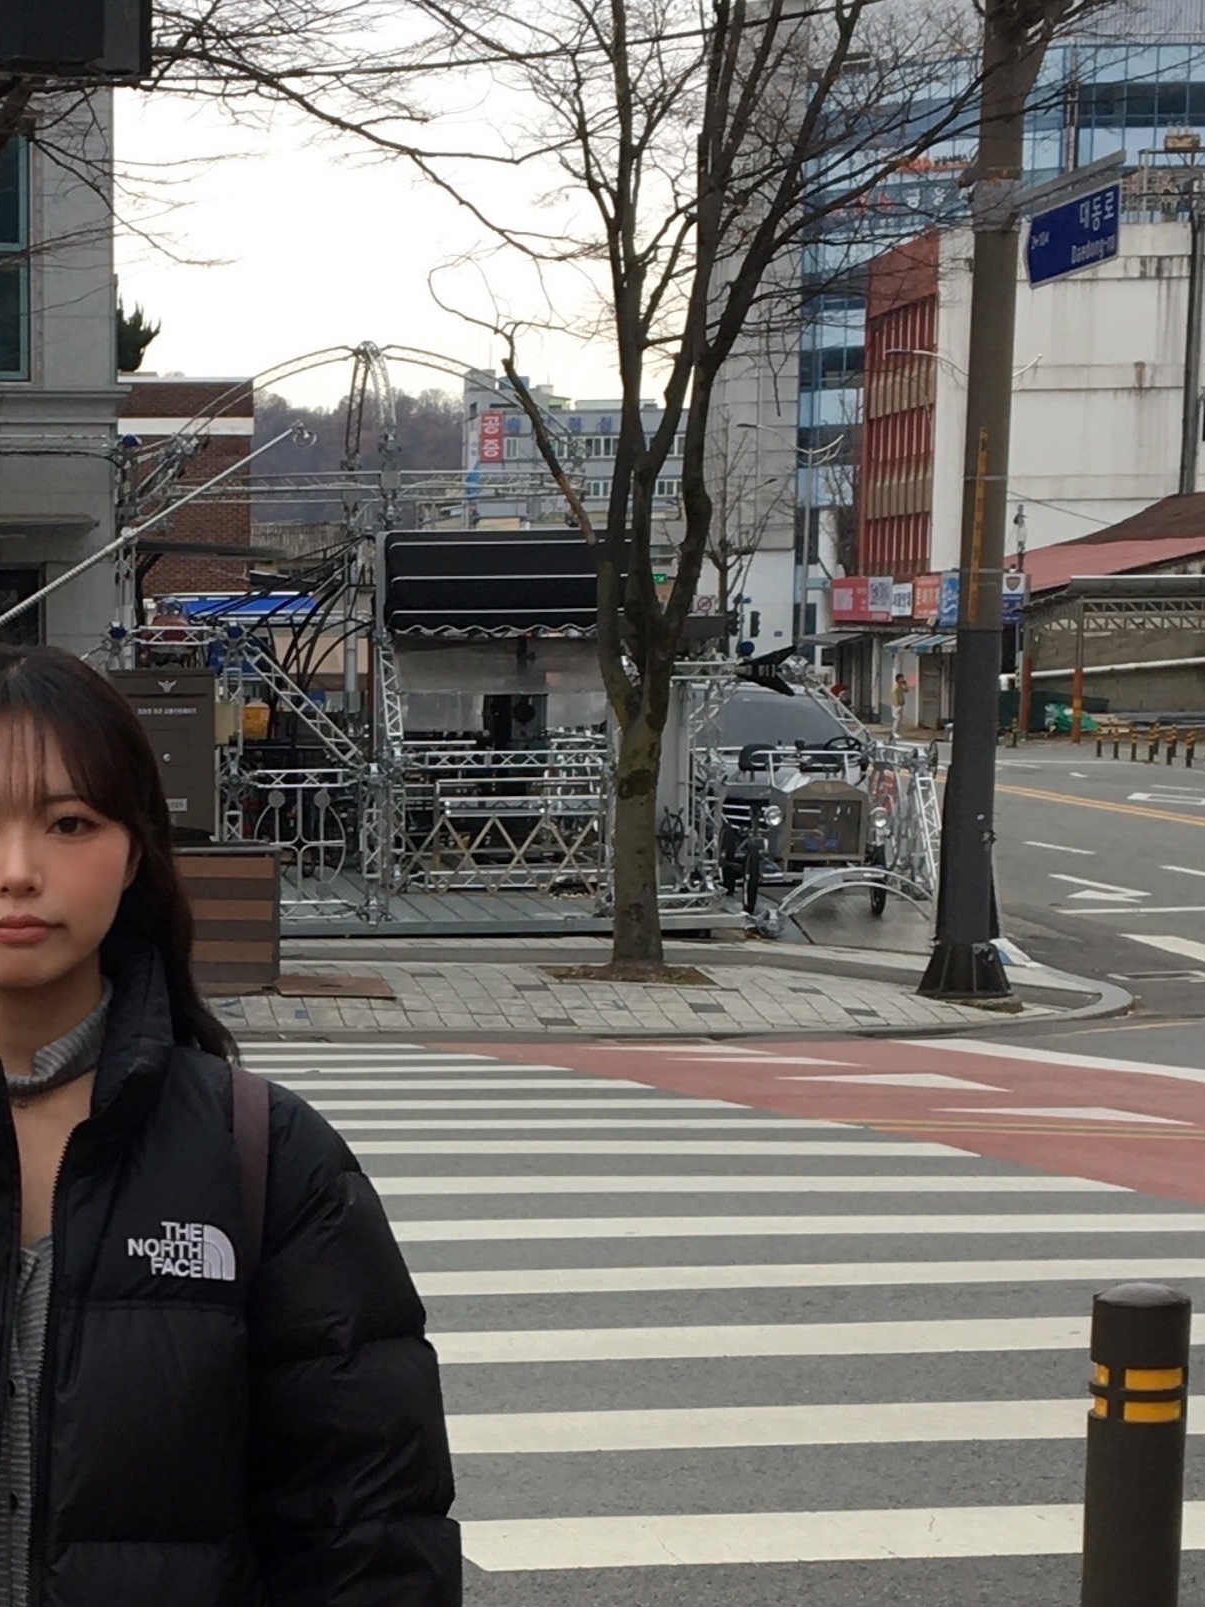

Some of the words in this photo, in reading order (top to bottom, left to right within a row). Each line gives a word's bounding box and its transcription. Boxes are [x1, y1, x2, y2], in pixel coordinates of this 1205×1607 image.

[1079, 191, 1115, 232] 대동로
[1070, 234, 1116, 265] Daedong-ro
[160, 1221, 203, 1241] THE
[127, 1238, 202, 1260] NORTH
[150, 1257, 203, 1278] FACE
